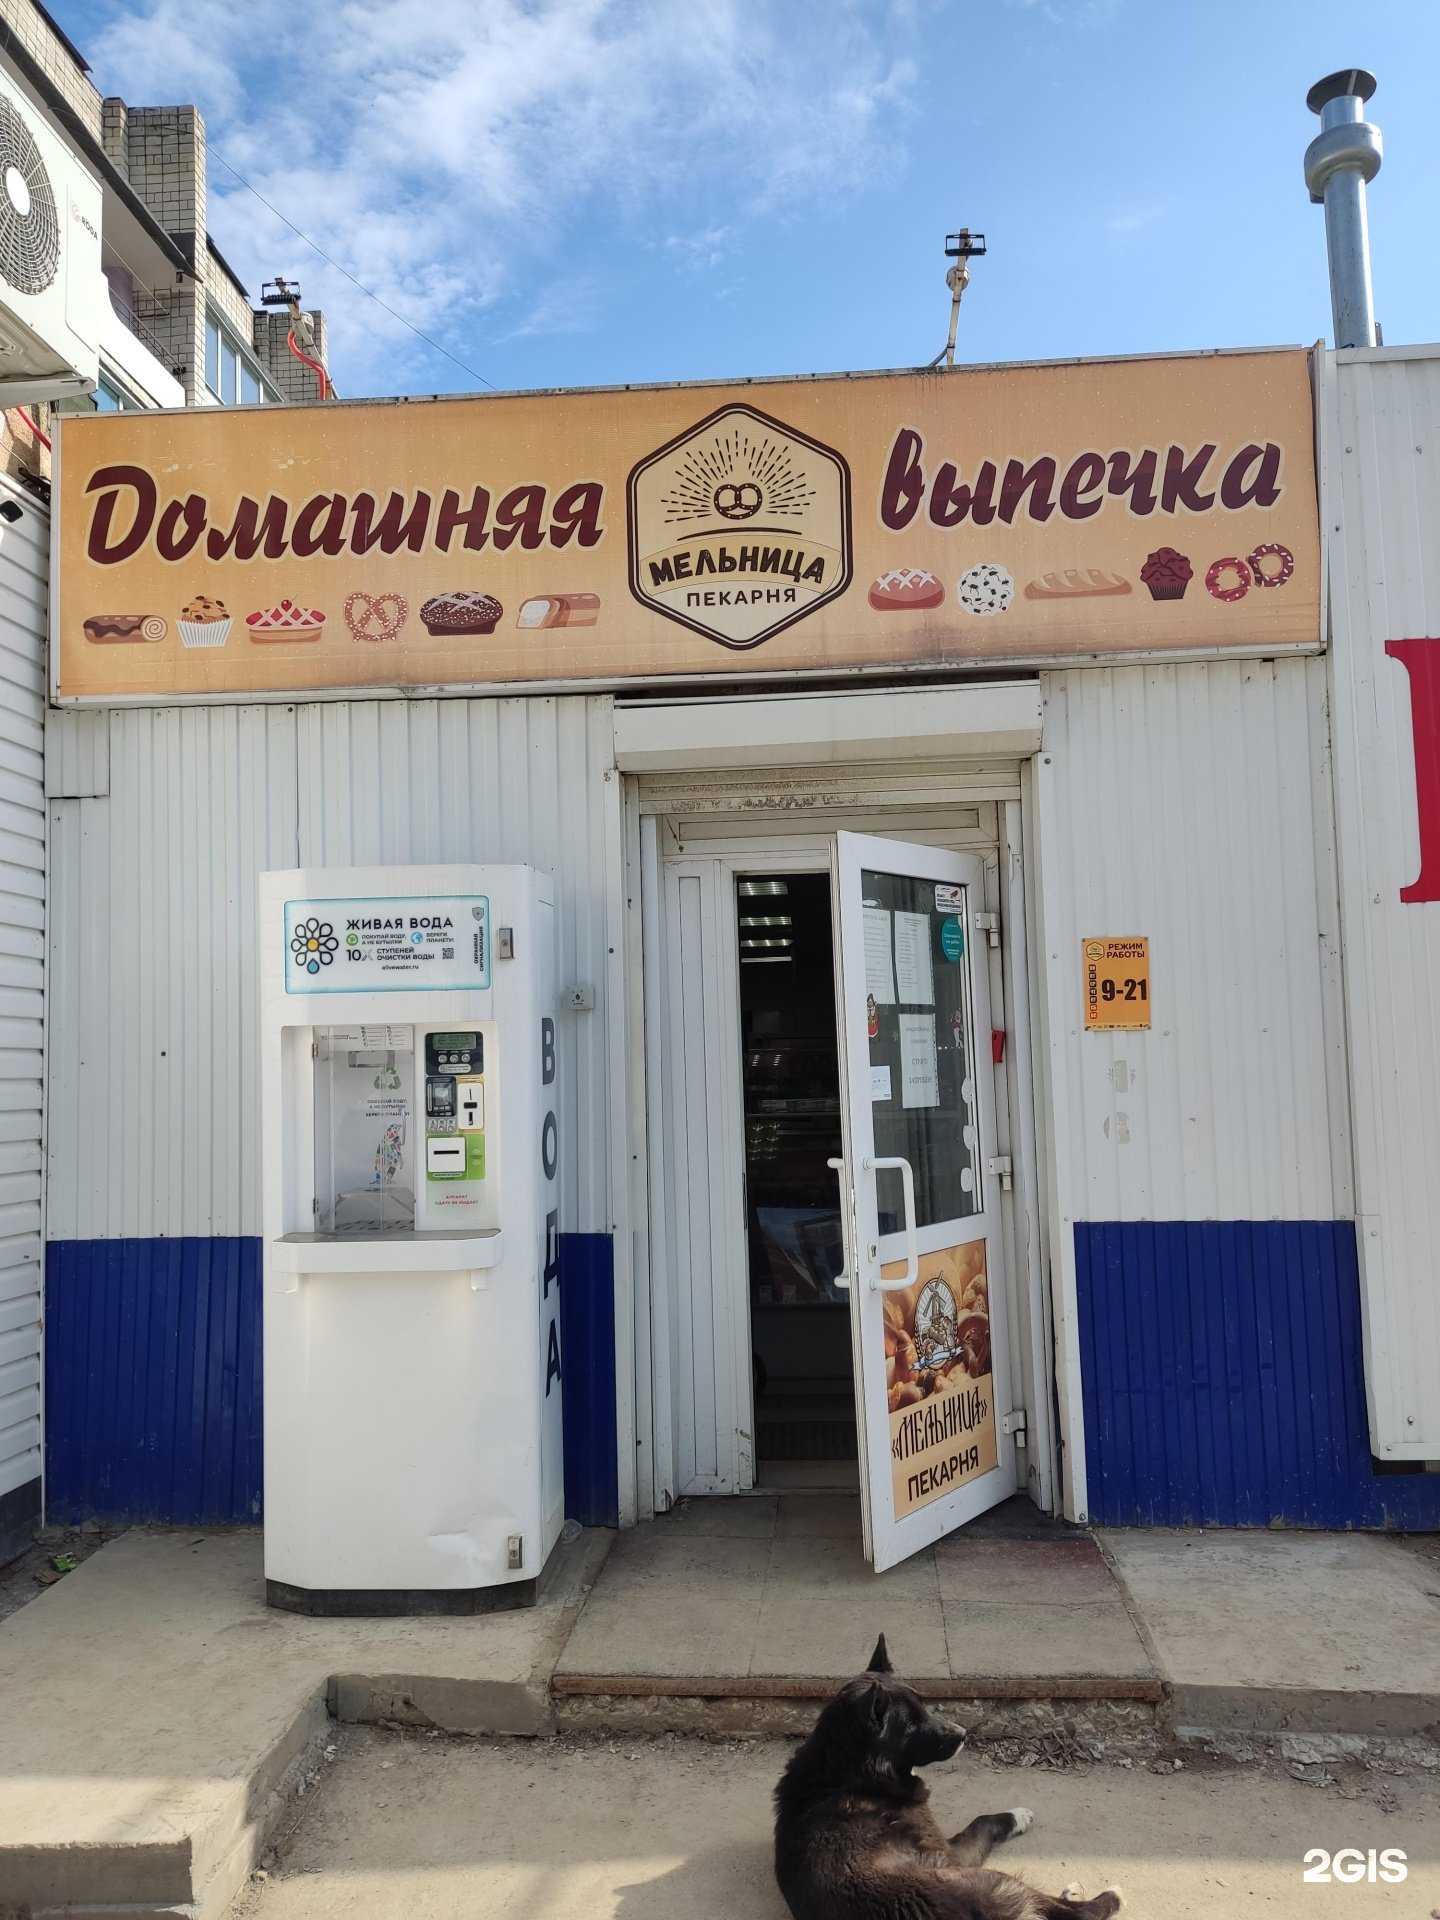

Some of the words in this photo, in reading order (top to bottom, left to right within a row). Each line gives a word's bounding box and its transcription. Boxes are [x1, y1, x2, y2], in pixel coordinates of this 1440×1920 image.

[84, 464, 604, 564] Домашняя
[880, 427, 1281, 532] выпечка
[649, 546, 825, 587] МЕЛЬНИЦА
[687, 588, 796, 607] ПЕКАРНЯ
[346, 918, 403, 930] ЖИВАЯ
[410, 917, 453, 929] ВОДА
[1101, 979, 1147, 1001] 9-21
[908, 1445, 979, 1502] ПЕКАРНЯ
